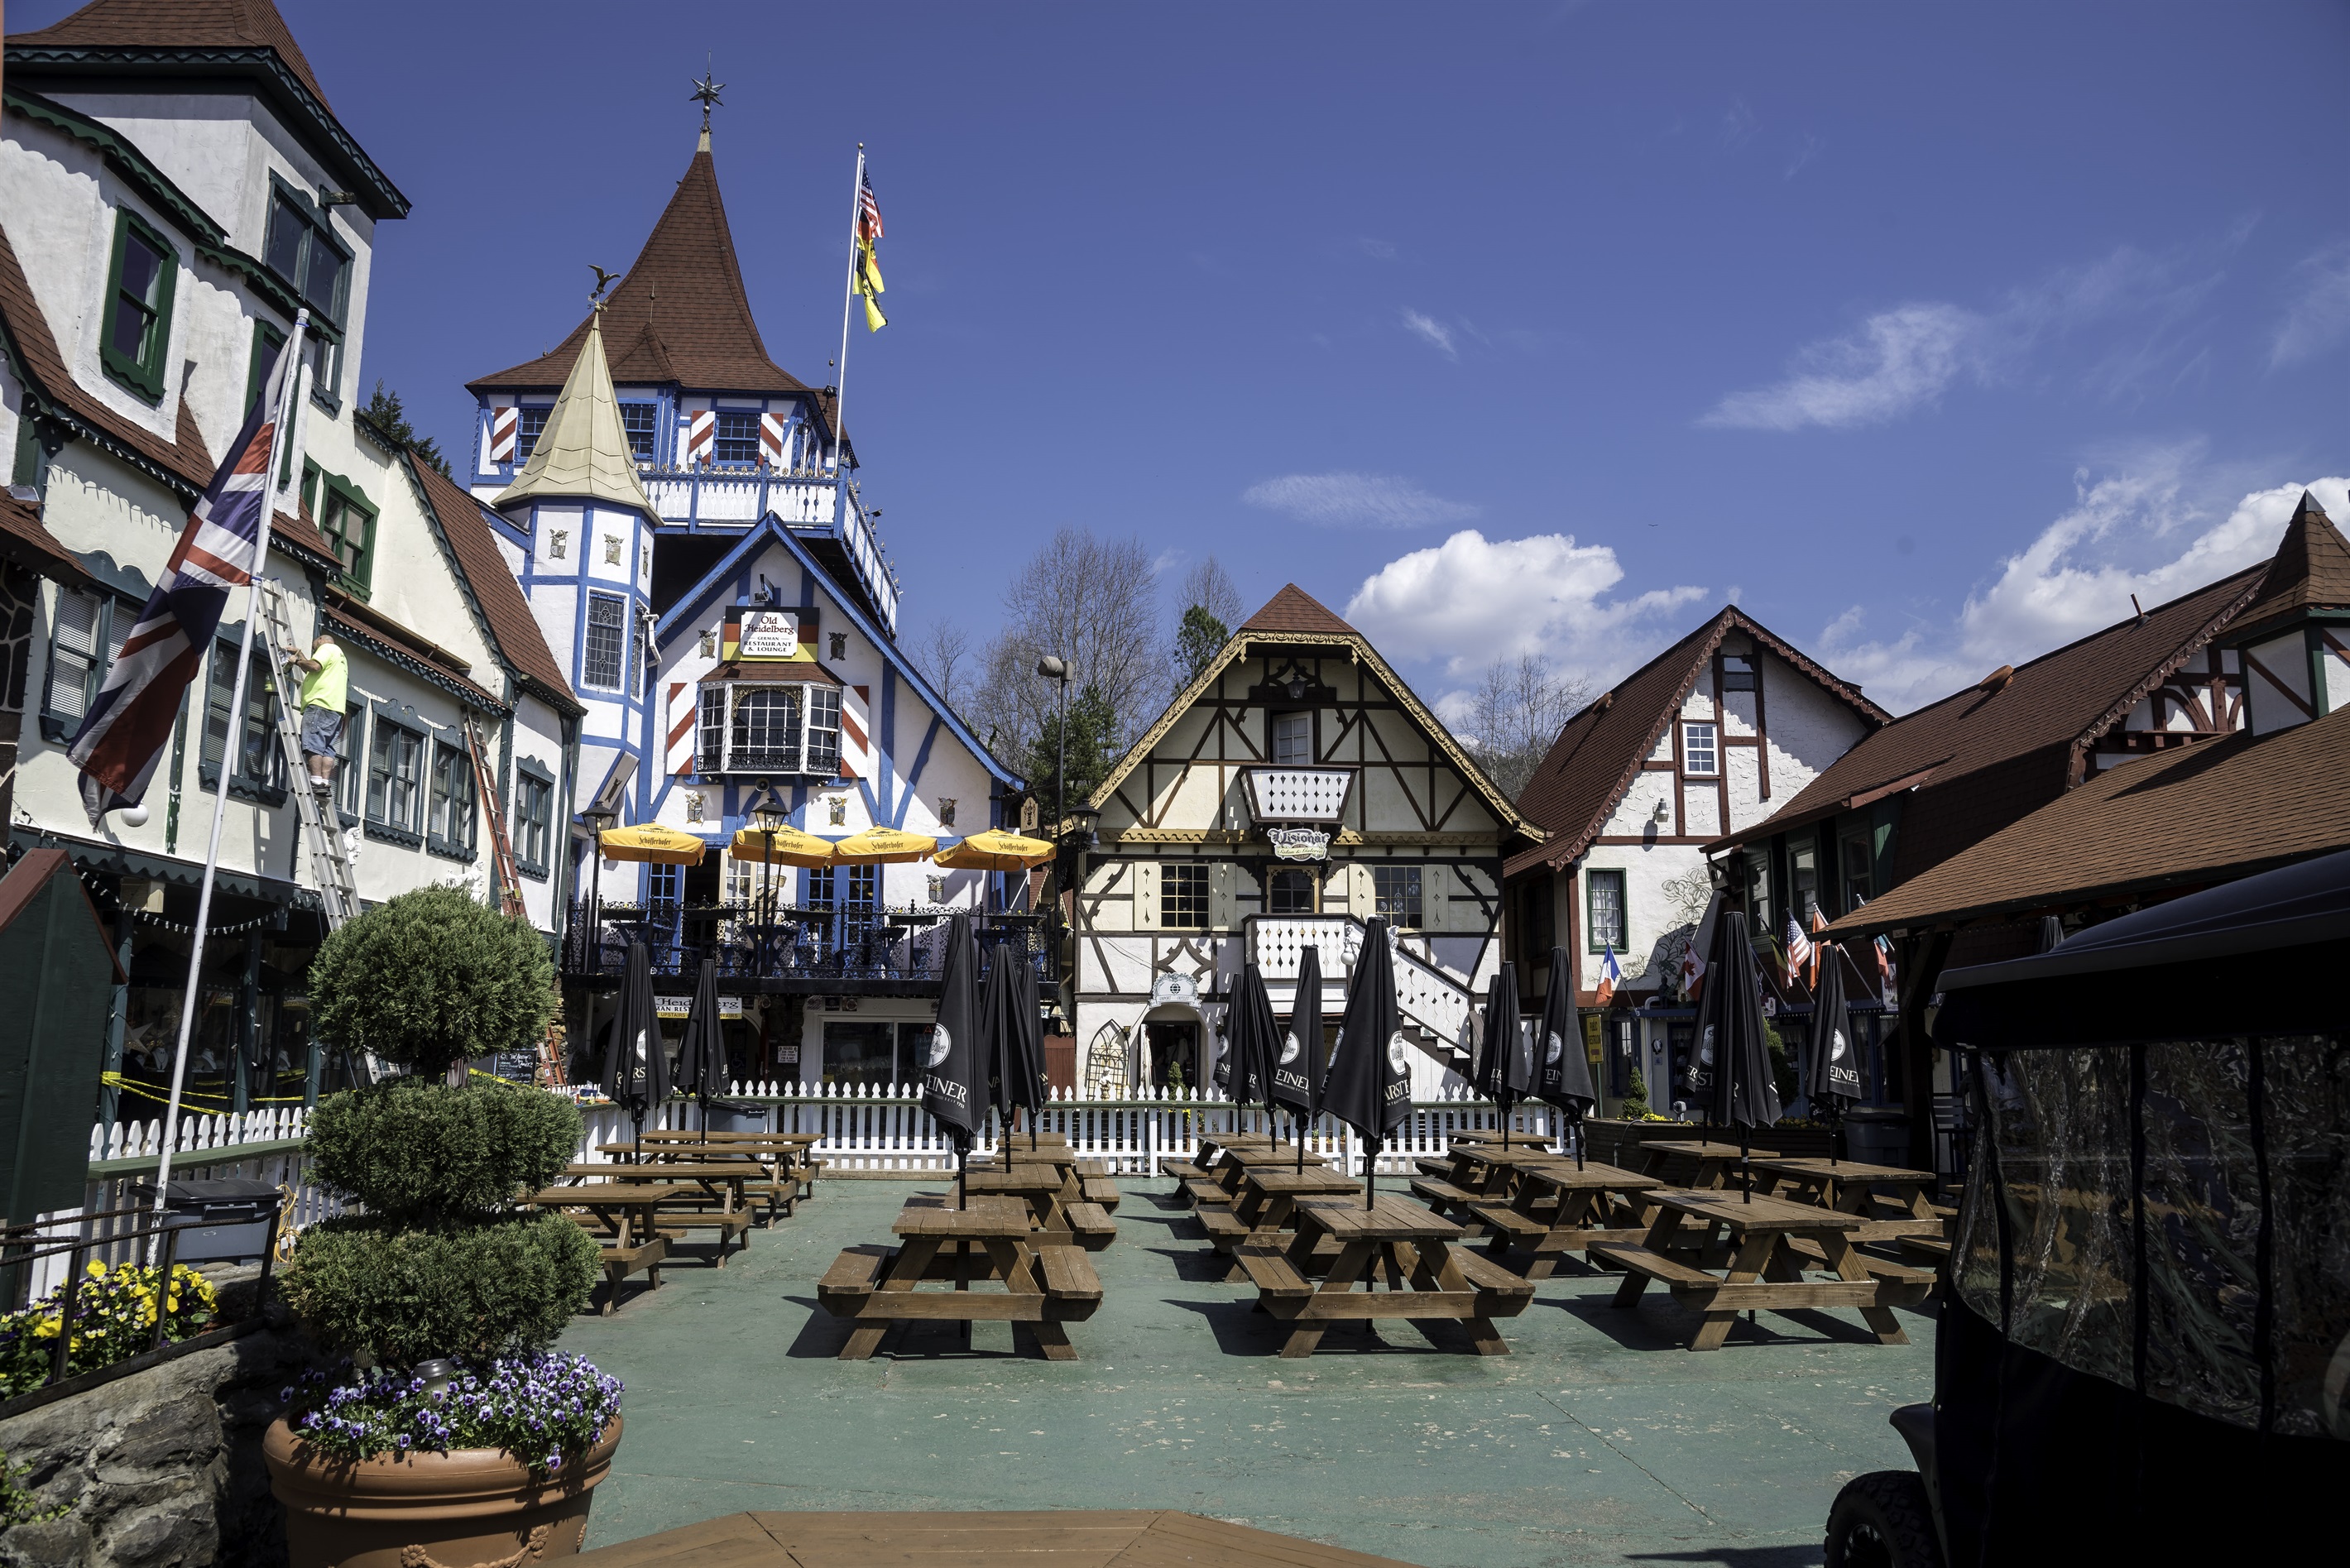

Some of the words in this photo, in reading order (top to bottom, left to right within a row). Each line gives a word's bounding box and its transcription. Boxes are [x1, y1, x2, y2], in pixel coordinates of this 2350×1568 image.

[760, 616, 778, 624] Old
[743, 624, 794, 635] Heidelberg
[926, 1074, 966, 1103] EINER
